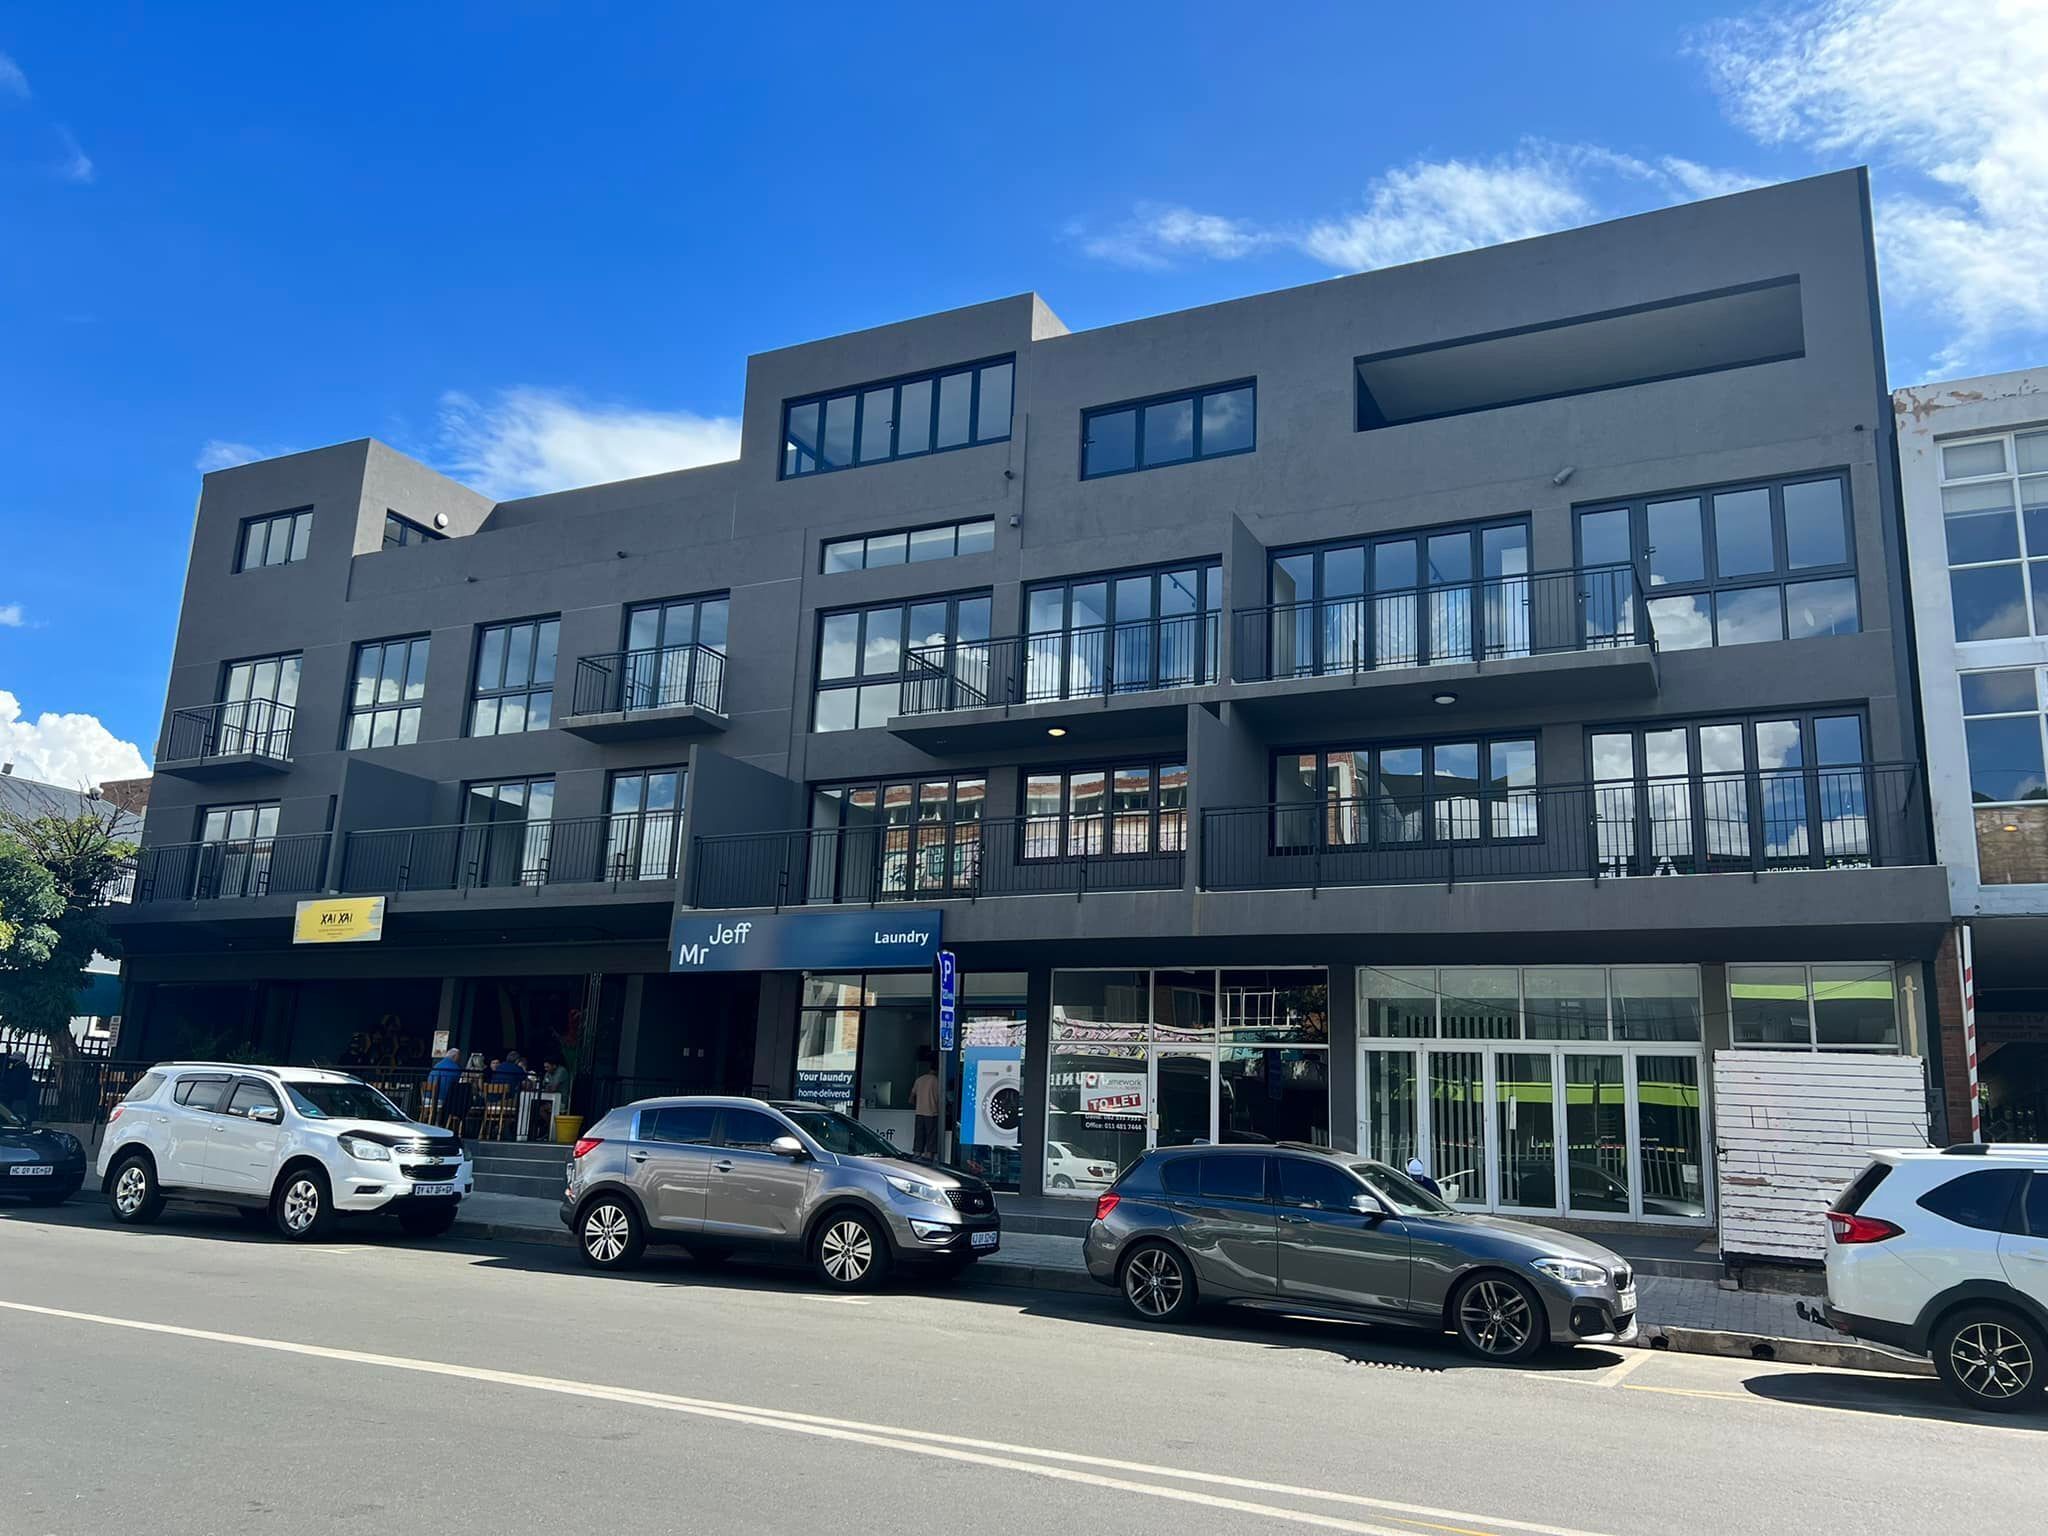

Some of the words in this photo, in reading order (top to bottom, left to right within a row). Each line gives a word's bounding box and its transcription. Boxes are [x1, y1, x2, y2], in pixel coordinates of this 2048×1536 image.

[320, 913, 336, 925] XAI
[338, 912, 353, 924] XAI
[709, 922, 752, 945] Jeff
[874, 930, 929, 946] Laundry
[678, 943, 709, 965] Mr
[799, 1072, 818, 1081] Your
[820, 1072, 852, 1084] laundry
[798, 1088, 851, 1098] home-delivered
[1090, 1098, 1109, 1111] TO
[1112, 1094, 1139, 1108] LET
